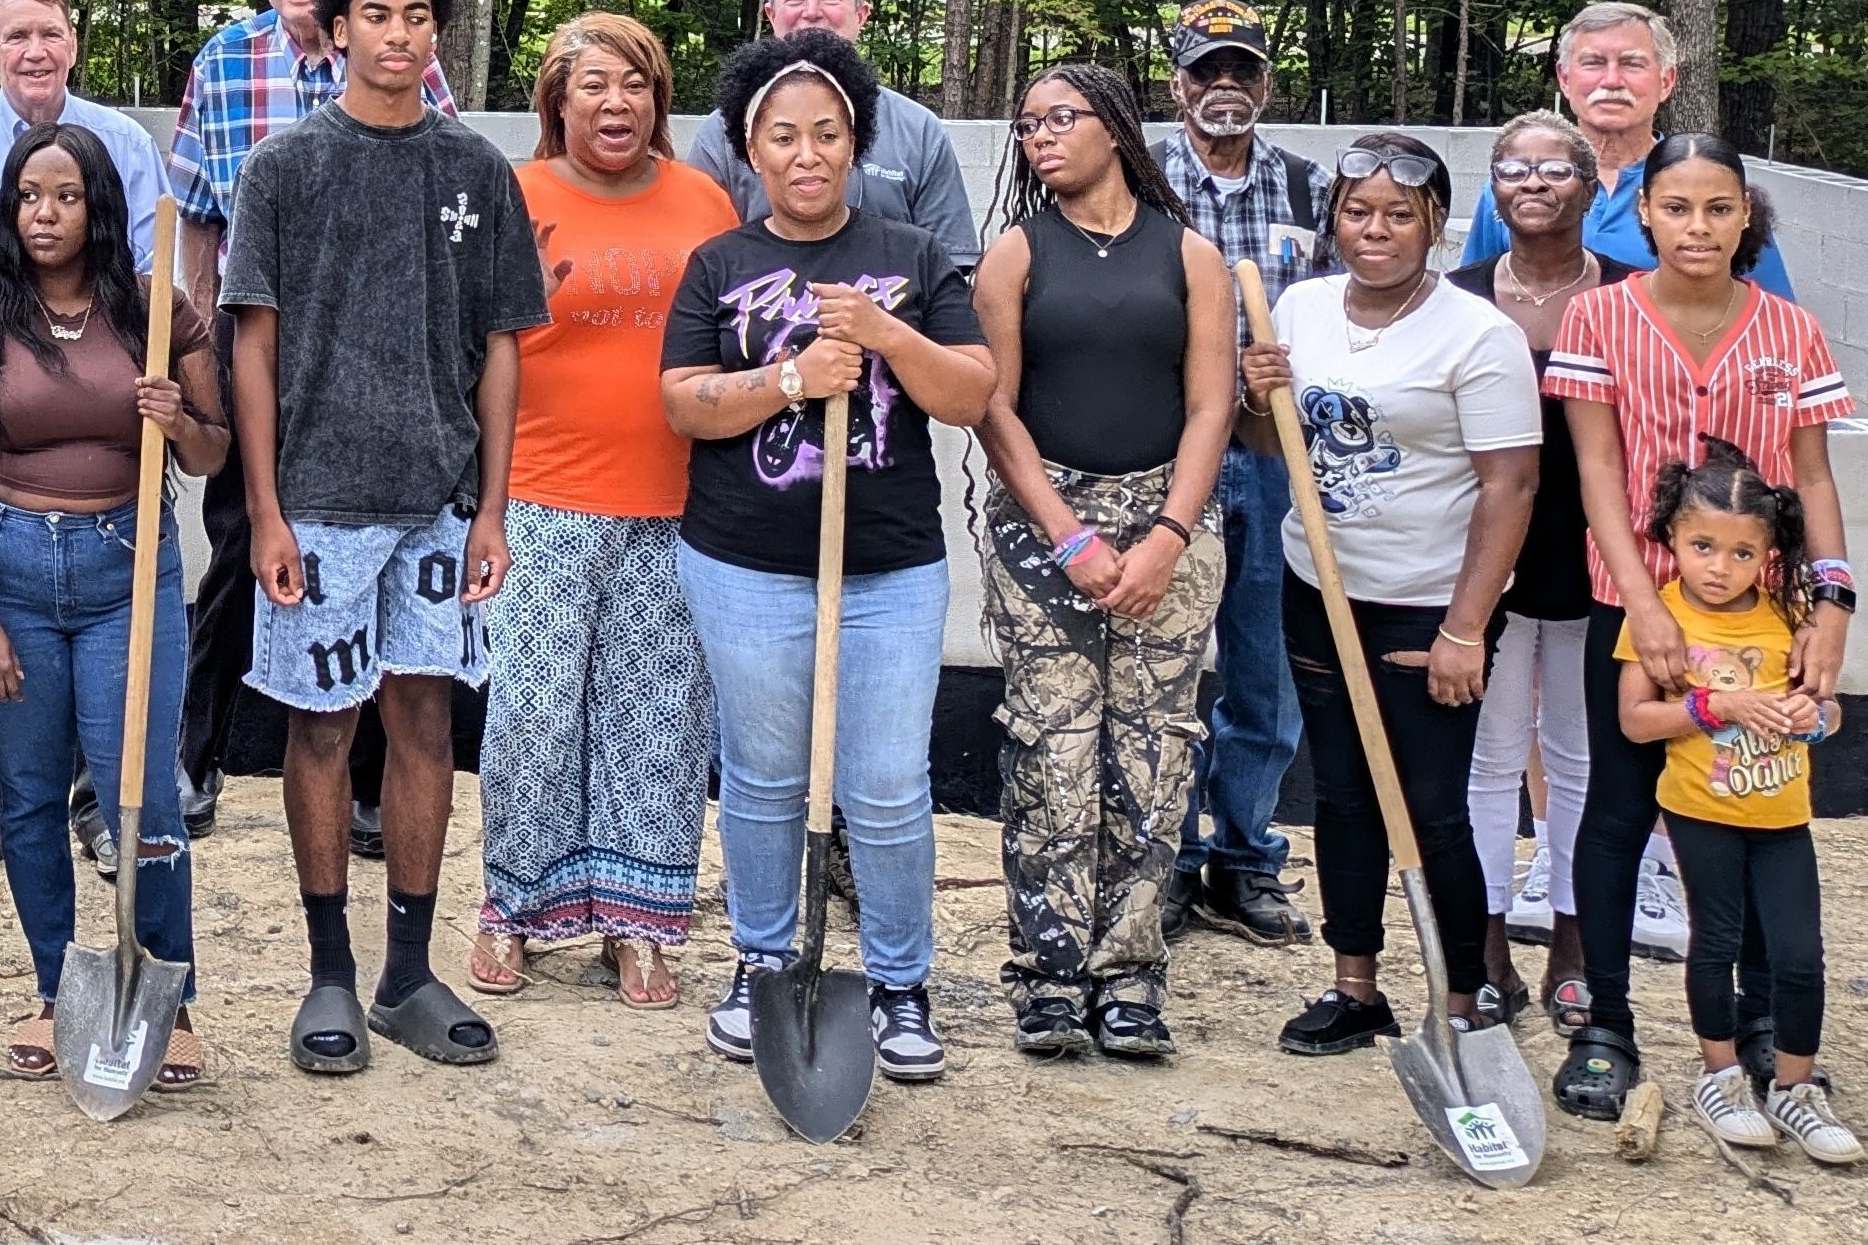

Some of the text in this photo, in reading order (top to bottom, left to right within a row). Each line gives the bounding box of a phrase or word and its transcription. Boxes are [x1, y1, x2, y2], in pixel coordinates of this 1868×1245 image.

[718, 268, 910, 360] Price
[1729, 750, 1802, 796] Dance
[1468, 1140, 1509, 1153] Habitat
